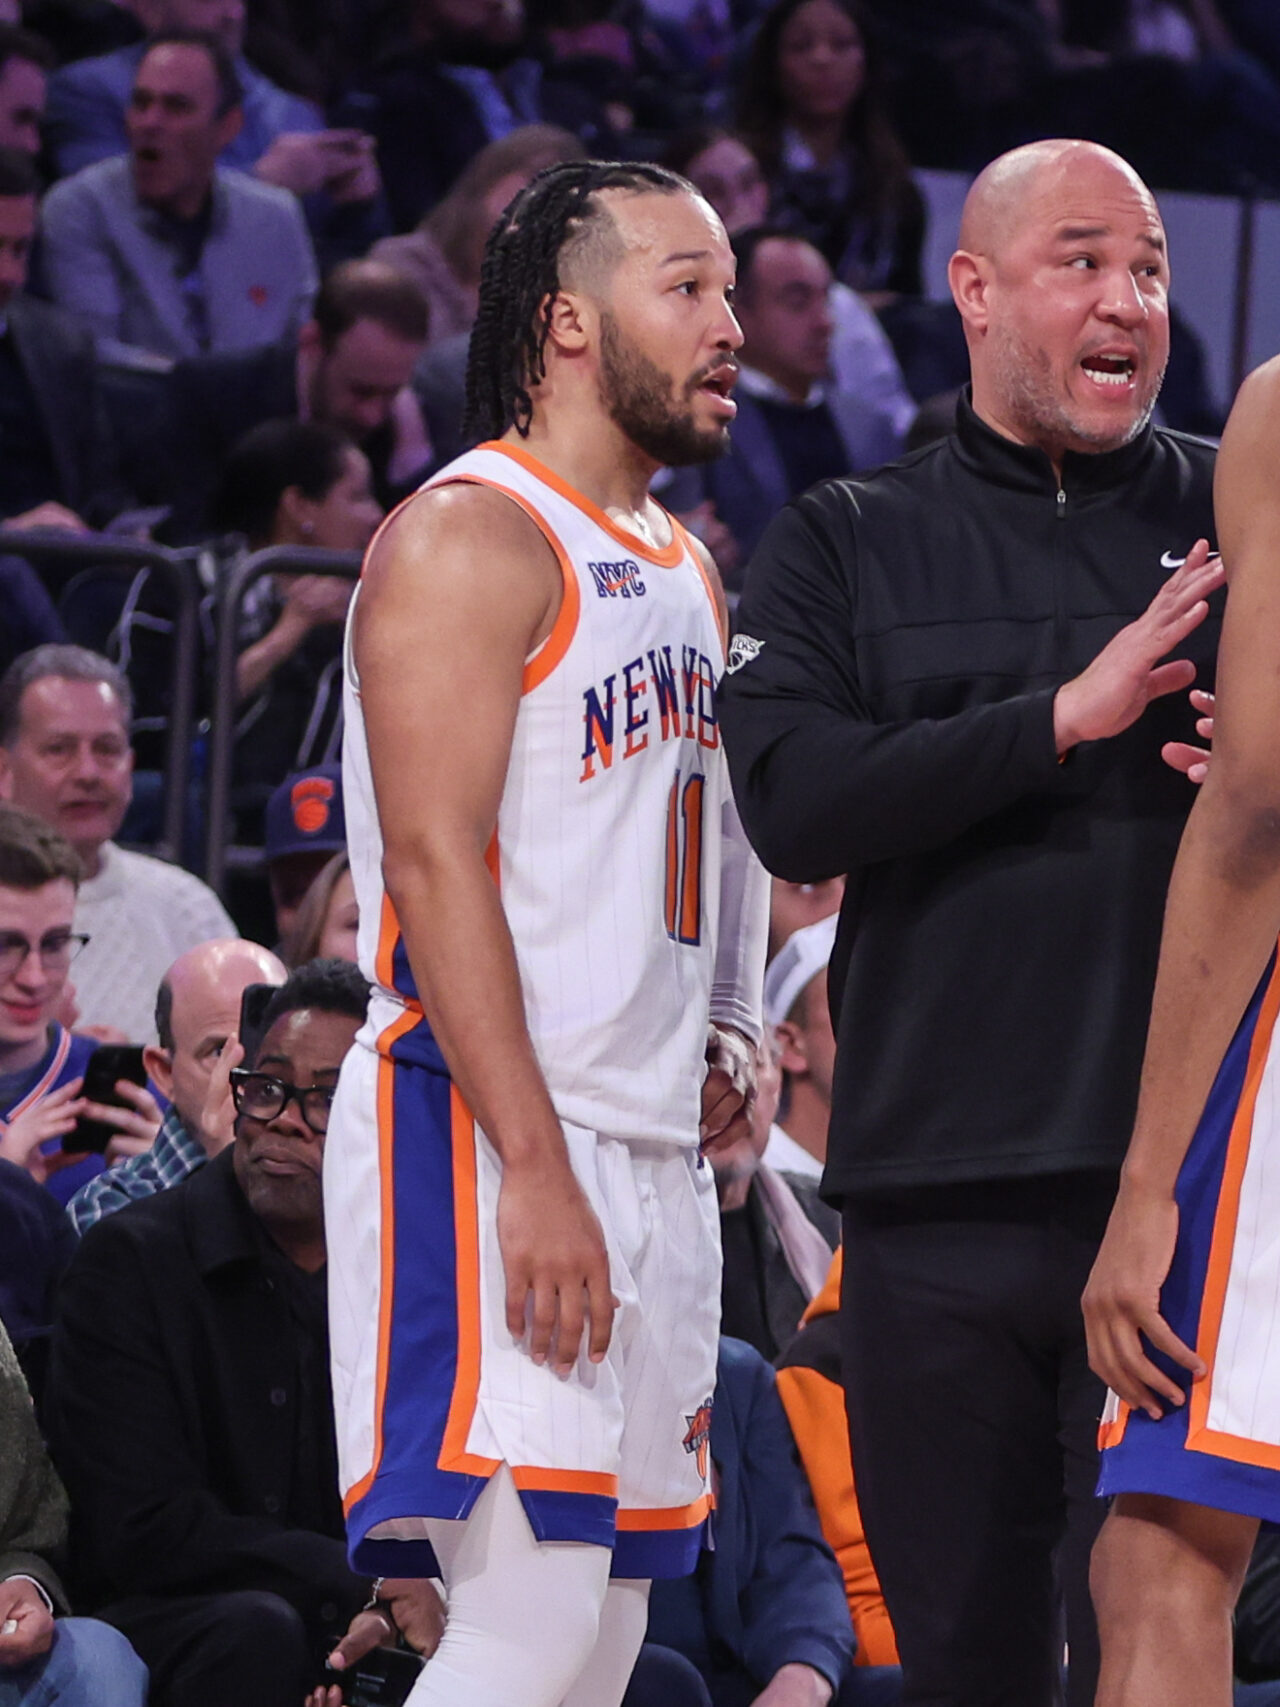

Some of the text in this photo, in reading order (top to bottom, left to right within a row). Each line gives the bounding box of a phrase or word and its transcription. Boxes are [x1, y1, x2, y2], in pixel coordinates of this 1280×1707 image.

[588, 560, 646, 598] NYC
[579, 643, 720, 784] NEW YO
[664, 769, 706, 946] 11
